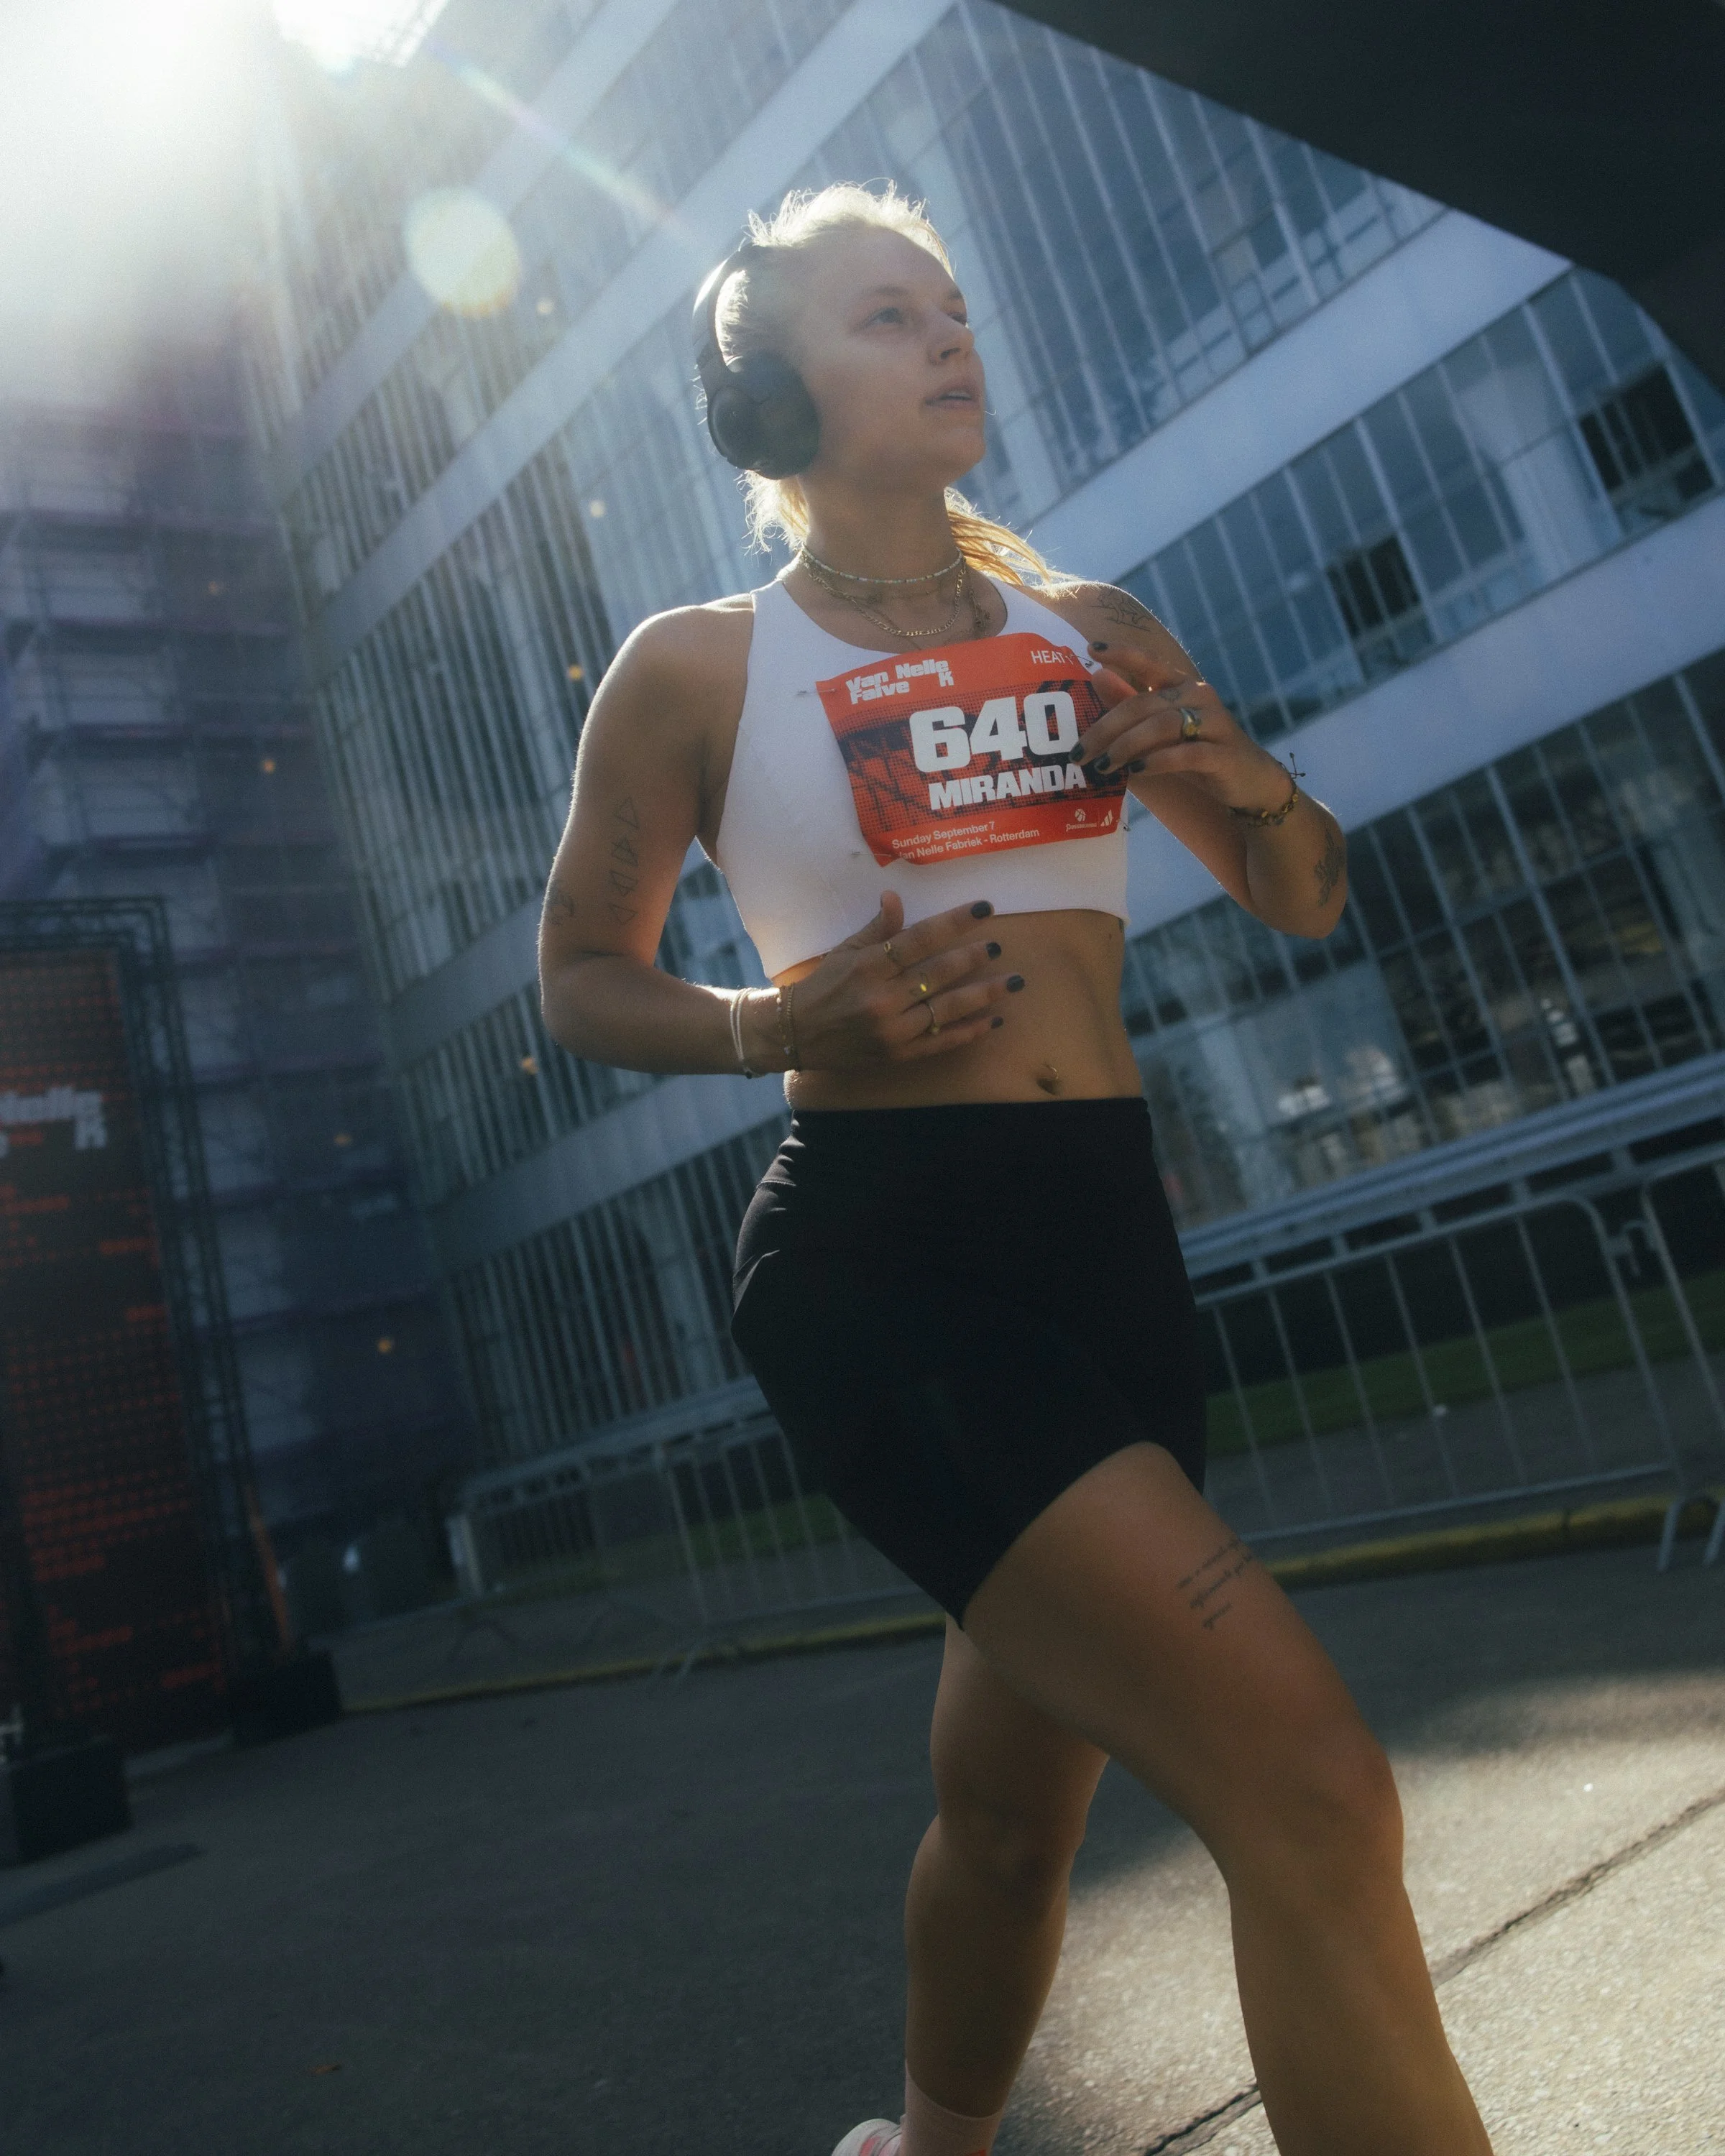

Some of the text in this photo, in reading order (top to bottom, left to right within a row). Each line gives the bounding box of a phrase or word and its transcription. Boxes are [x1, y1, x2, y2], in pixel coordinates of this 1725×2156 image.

[1030, 650, 1065, 665] HEAT
[845, 658, 949, 691] Van Nelle
[938, 671, 954, 687] K
[909, 691, 1080, 773] 640
[928, 764, 1087, 811] MIRANDA
[891, 821, 995, 849] Sunday September 7
[916, 844, 944, 857] Nelle
[946, 837, 983, 851] Fabriek
[989, 829, 1040, 844] Rotterdam
